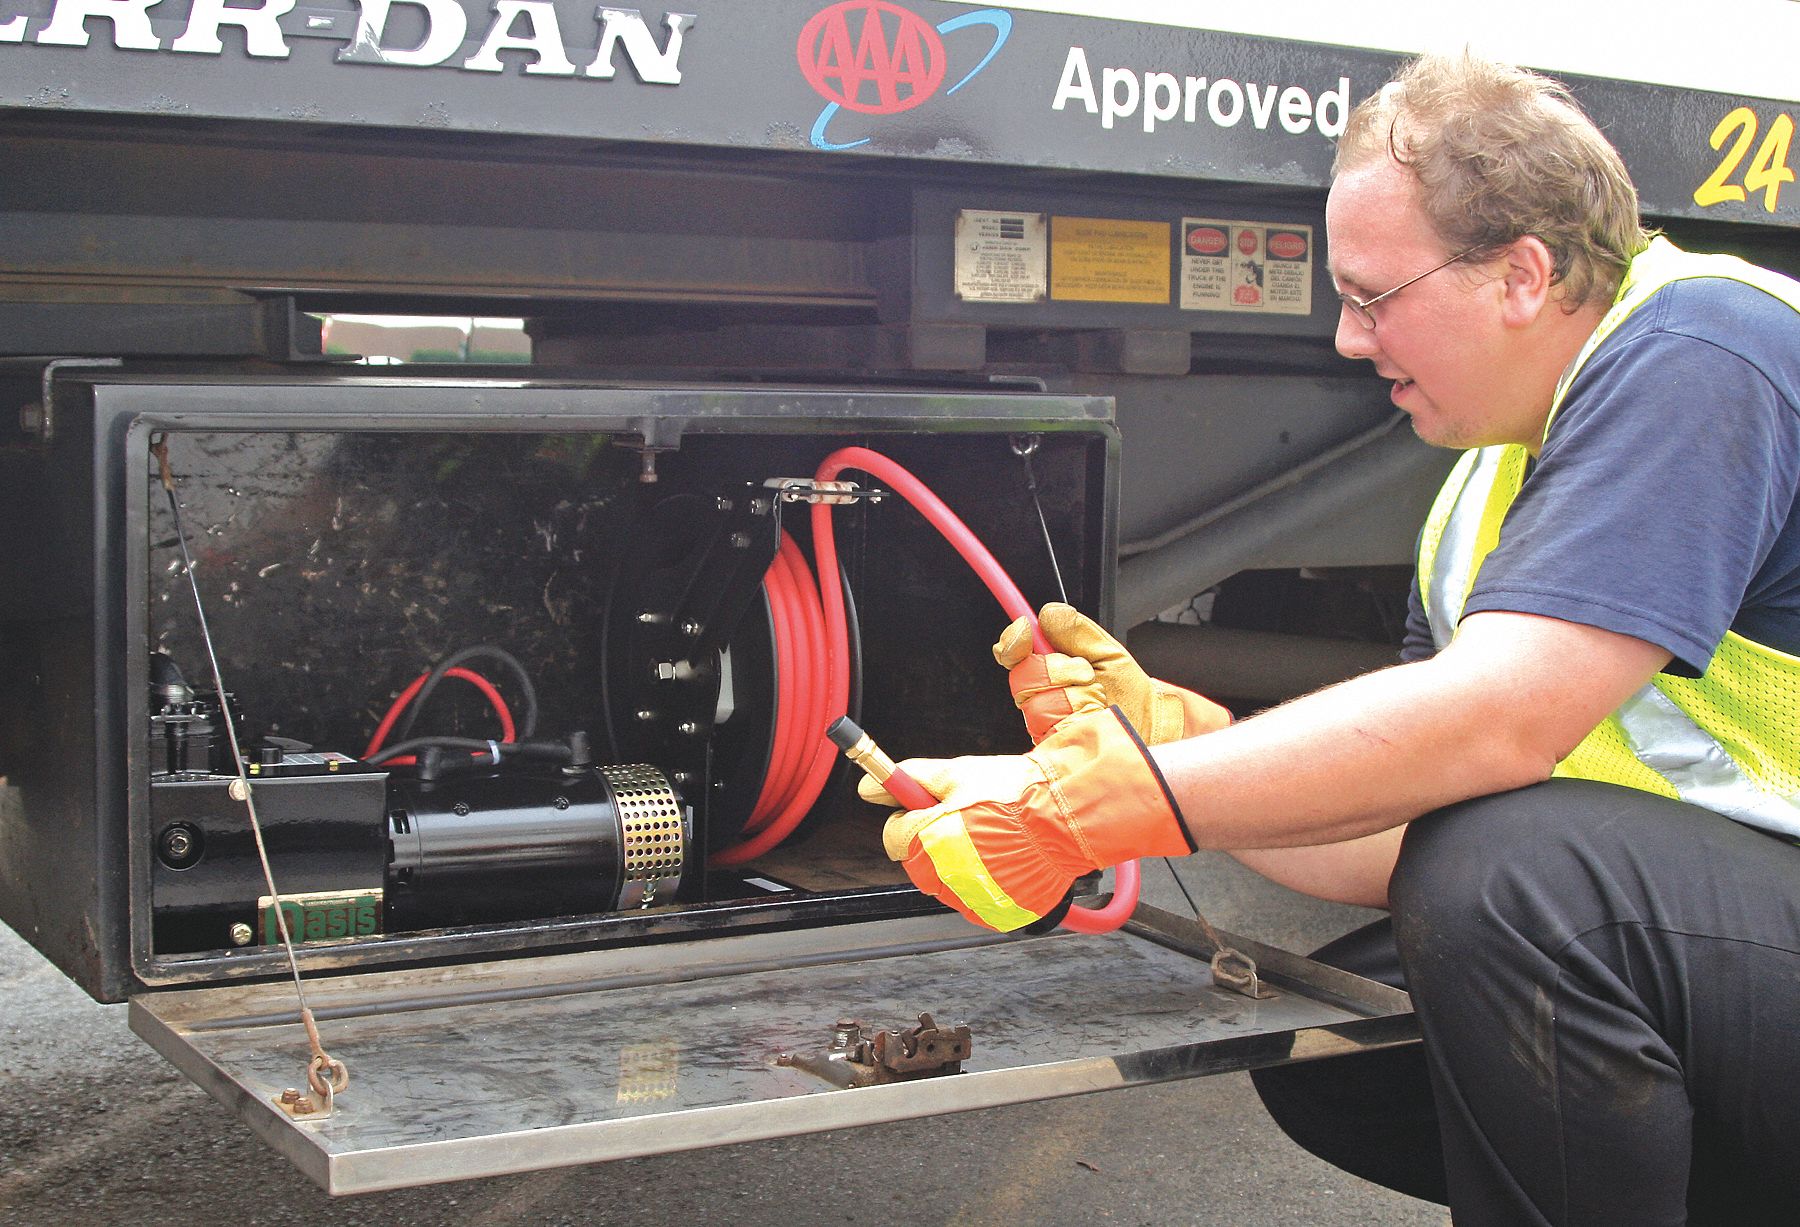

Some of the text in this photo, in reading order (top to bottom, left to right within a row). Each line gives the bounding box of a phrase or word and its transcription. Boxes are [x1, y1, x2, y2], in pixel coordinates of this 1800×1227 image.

[0, 0, 696, 86] RR-DAN
[811, 3, 937, 109] AAA
[1052, 47, 1350, 137] Approved
[1693, 106, 1796, 214] 24
[264, 900, 377, 944] Oasis
